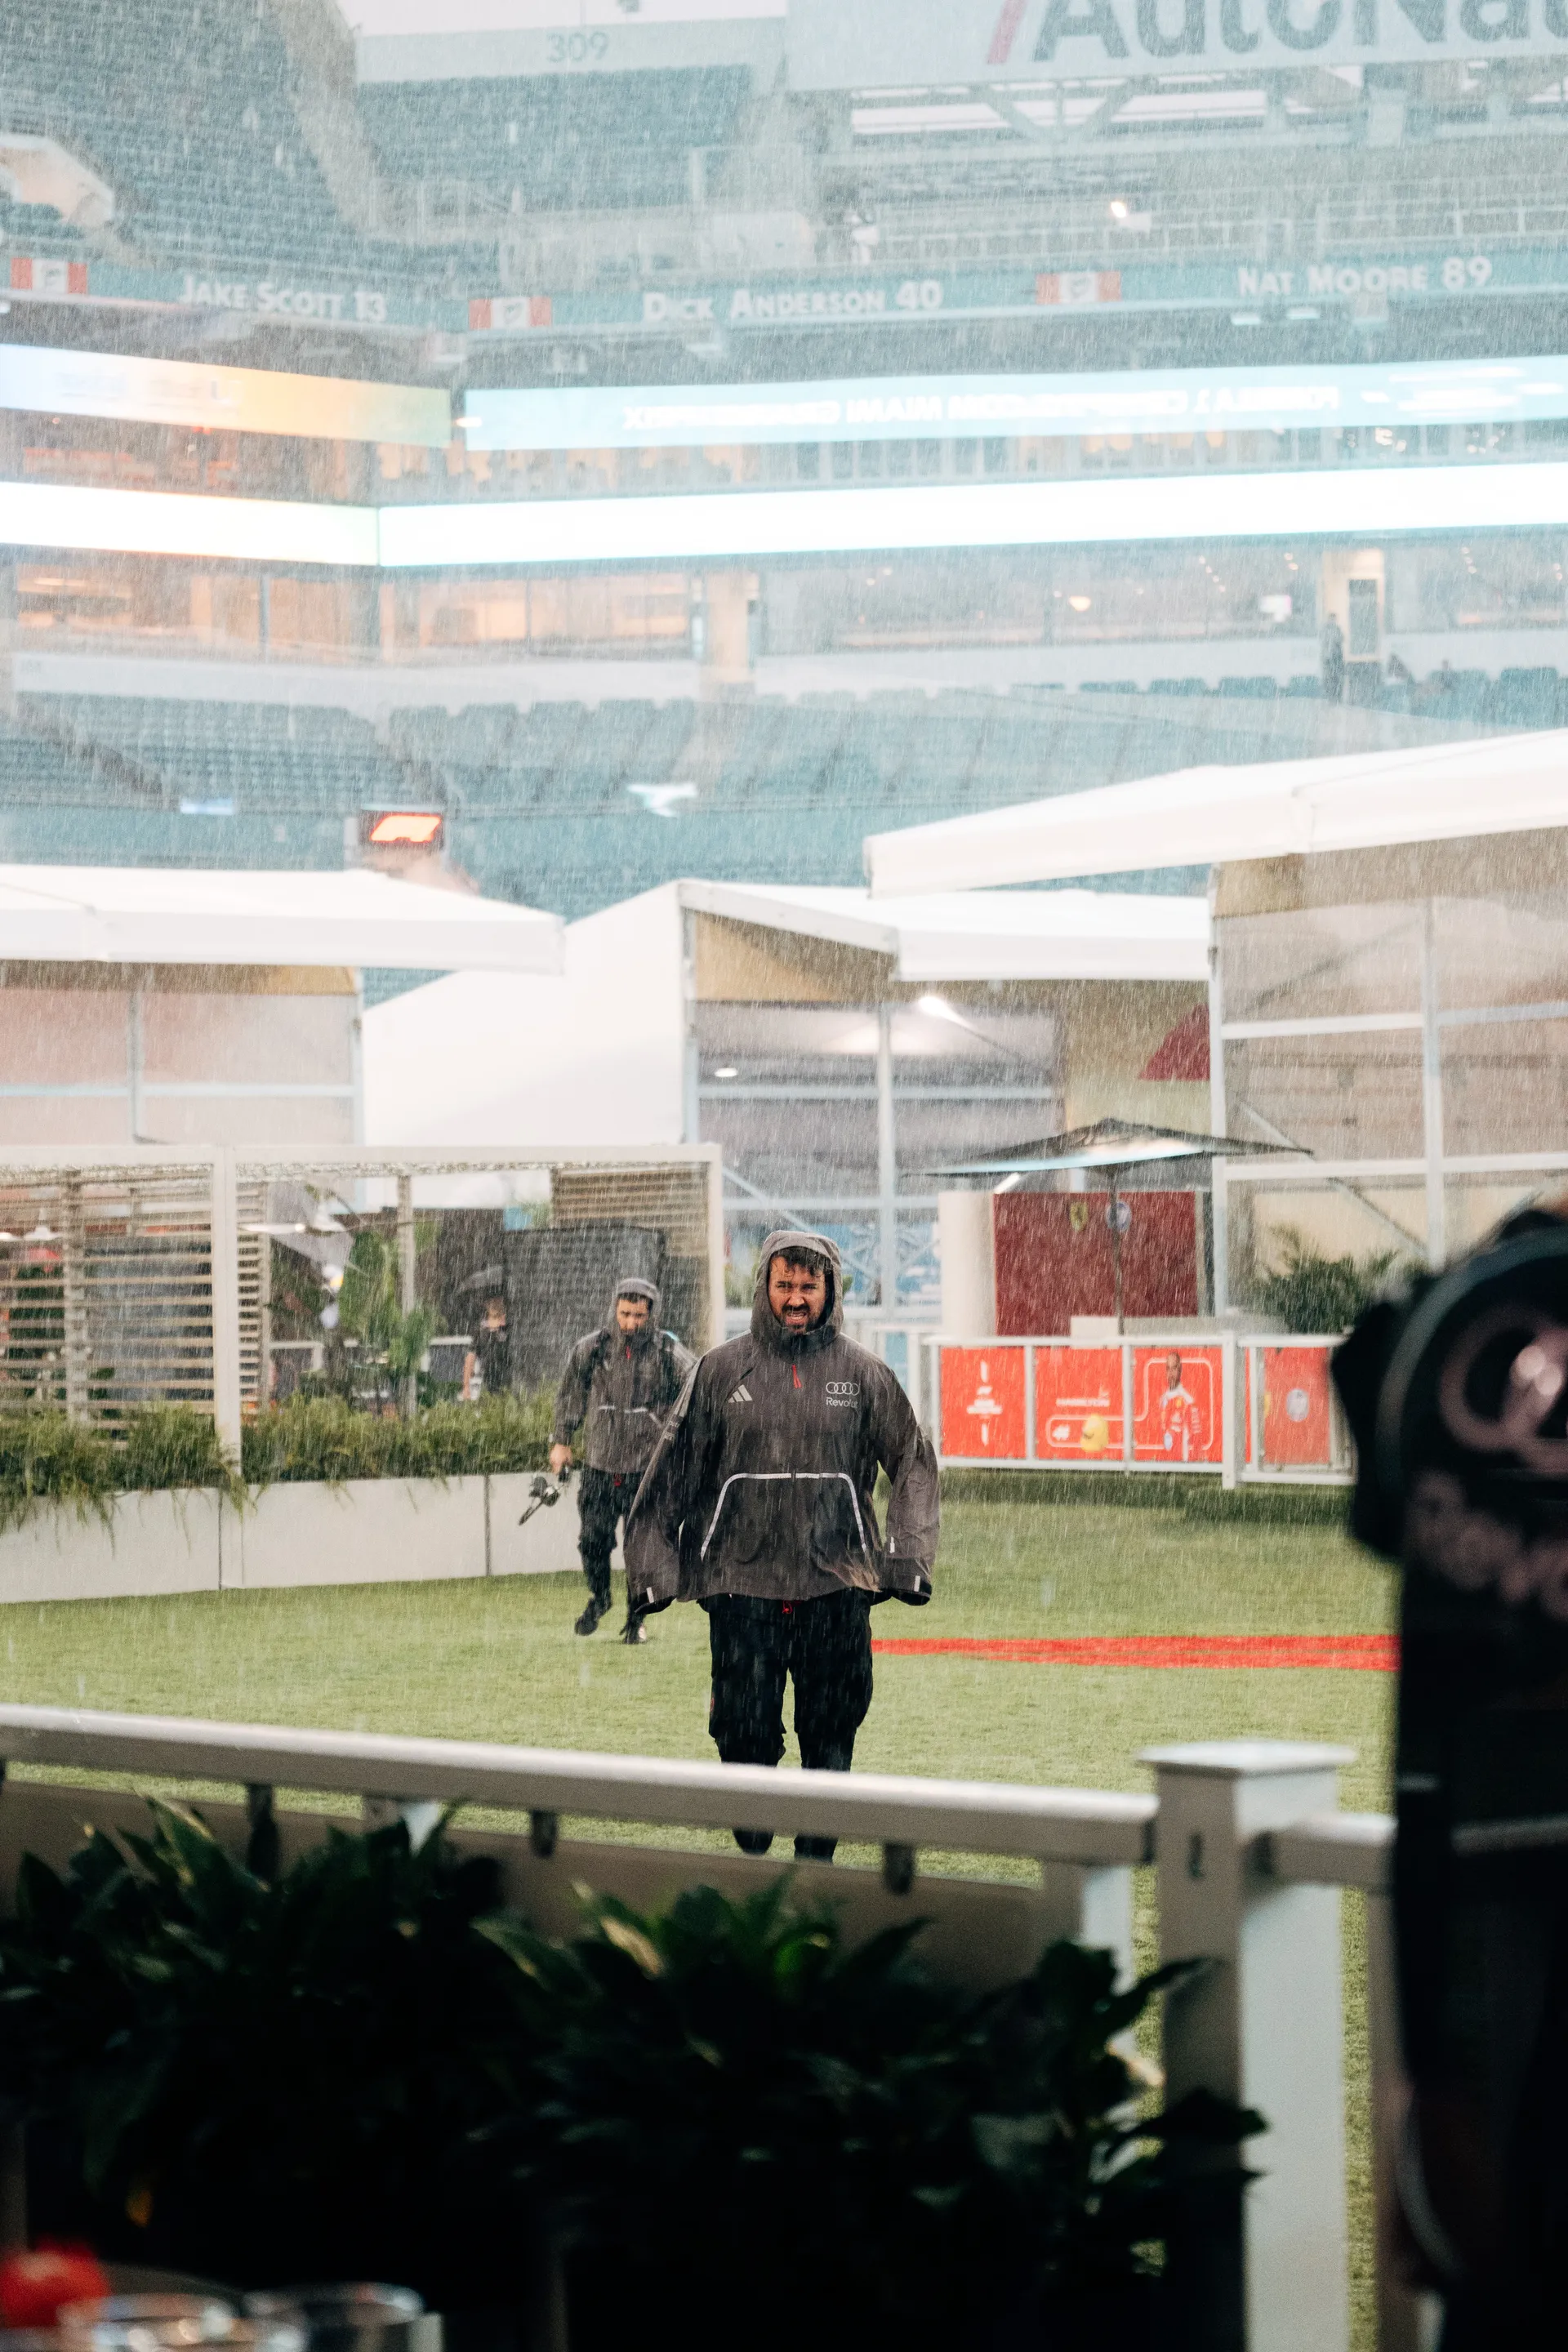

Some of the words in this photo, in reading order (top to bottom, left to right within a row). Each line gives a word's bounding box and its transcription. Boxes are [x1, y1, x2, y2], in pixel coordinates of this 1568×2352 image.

[546, 32, 609, 62] 309
[1442, 256, 1493, 291] 89
[354, 291, 386, 321] 13
[897, 279, 943, 310] 40
[826, 1396, 858, 1409] Revolut
